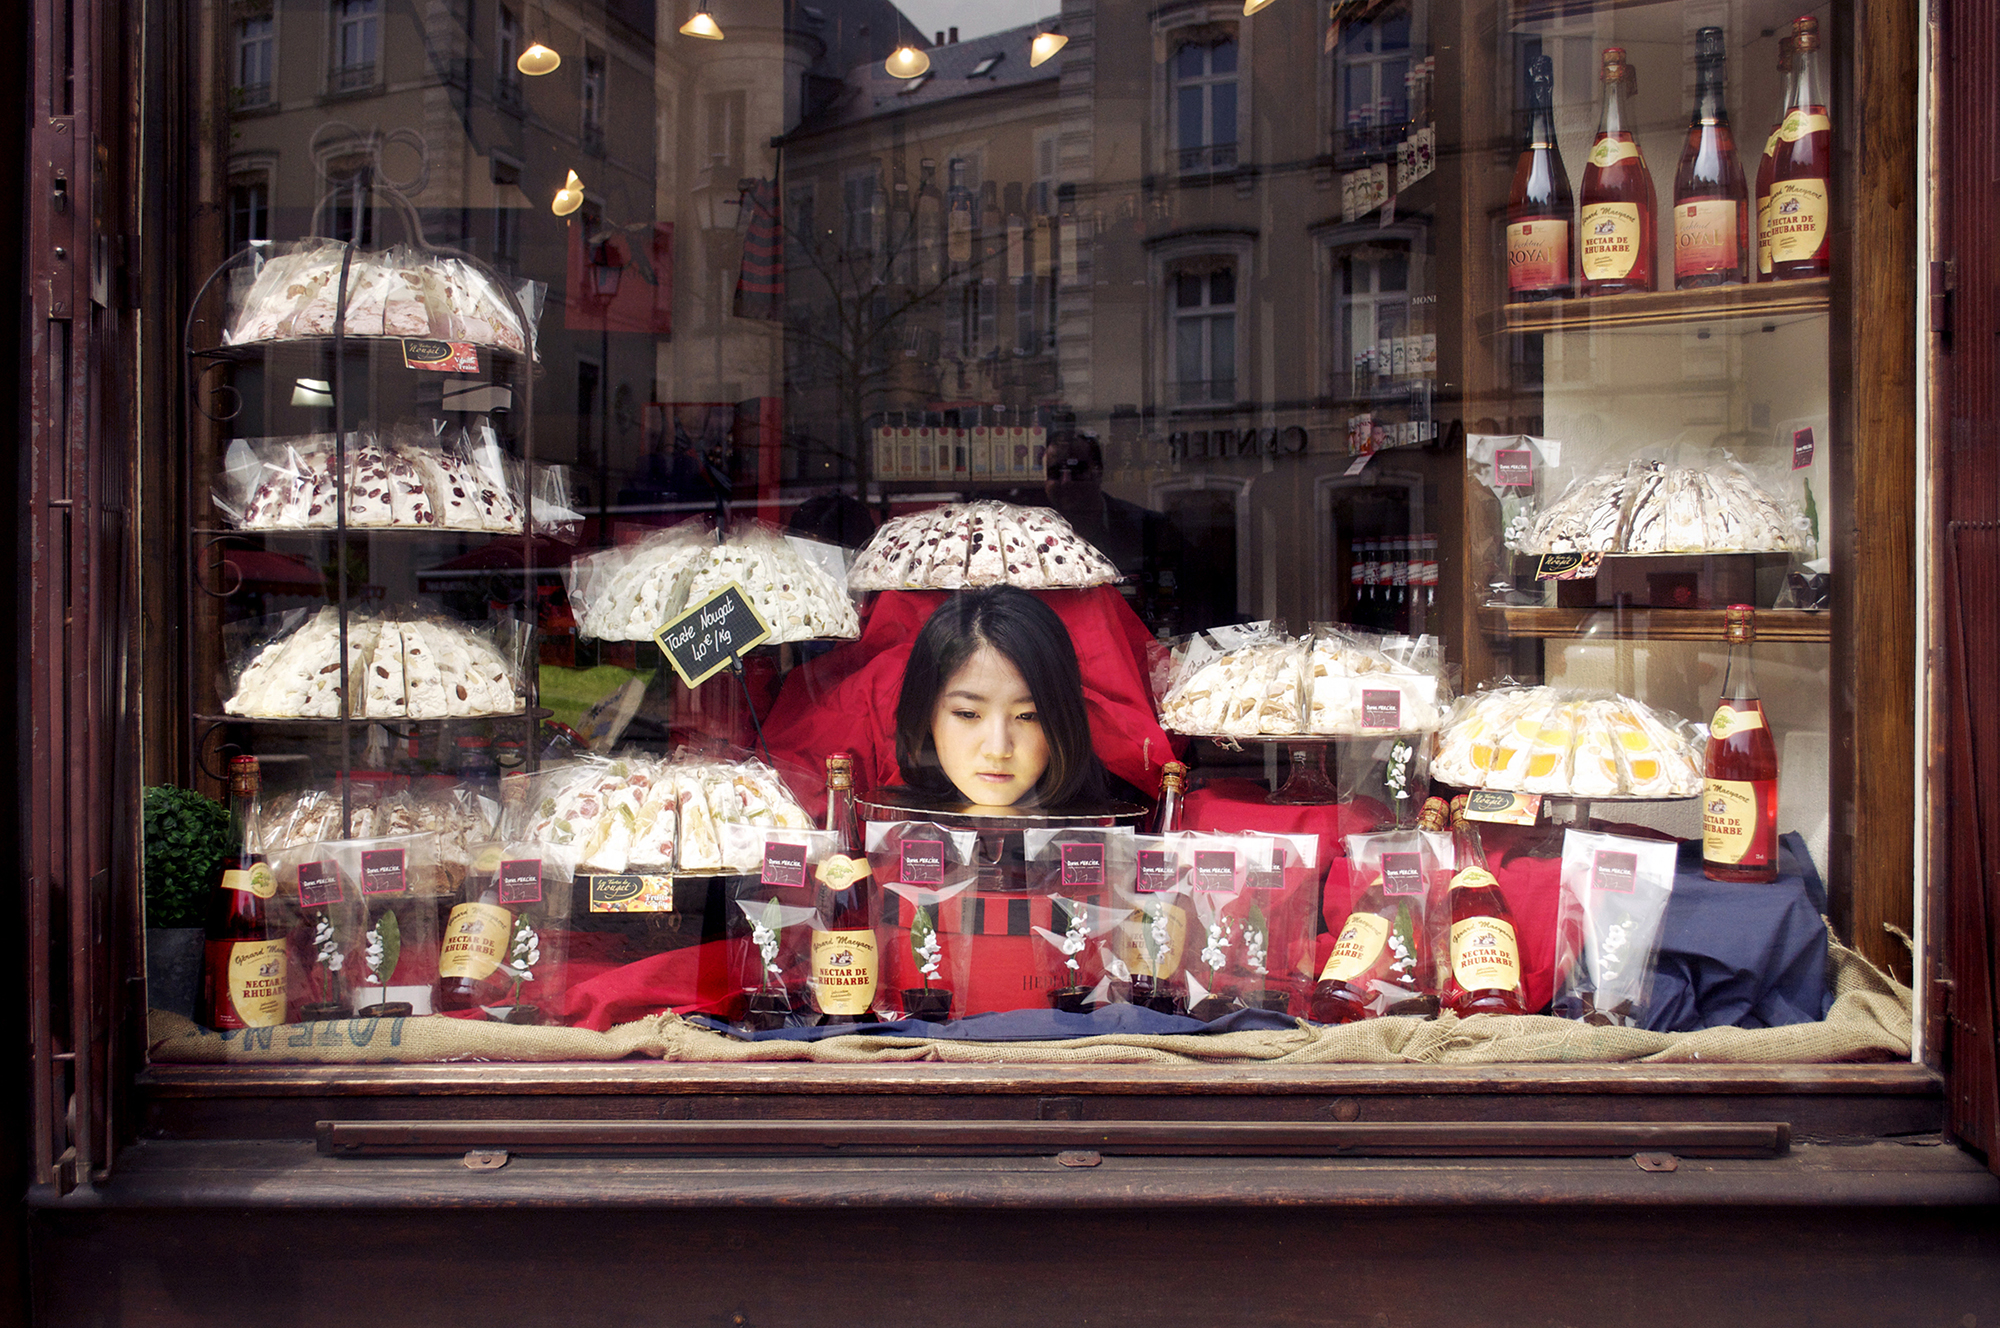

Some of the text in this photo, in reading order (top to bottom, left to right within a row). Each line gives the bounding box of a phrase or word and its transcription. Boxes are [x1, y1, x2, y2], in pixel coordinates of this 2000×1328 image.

[1801, 215, 1814, 223] DE
[1585, 236, 1629, 246] NECTAR DE
[1584, 244, 1631, 255] RHUBARBE
[1508, 246, 1557, 267] ROYAL
[700, 595, 735, 631] Nougat
[1728, 818, 1741, 826] DE
[447, 936, 495, 948] NECTAR DE
[1352, 943, 1365, 952] DE
[444, 944, 496, 957] RHUBARBE
[1461, 949, 1511, 960] NECTAR DE
[1460, 957, 1514, 969] RHUBARBE
[819, 968, 868, 977] NECTAR DE
[245, 978, 282, 989] NECTAR
[818, 976, 870, 986] RHUBARBE
